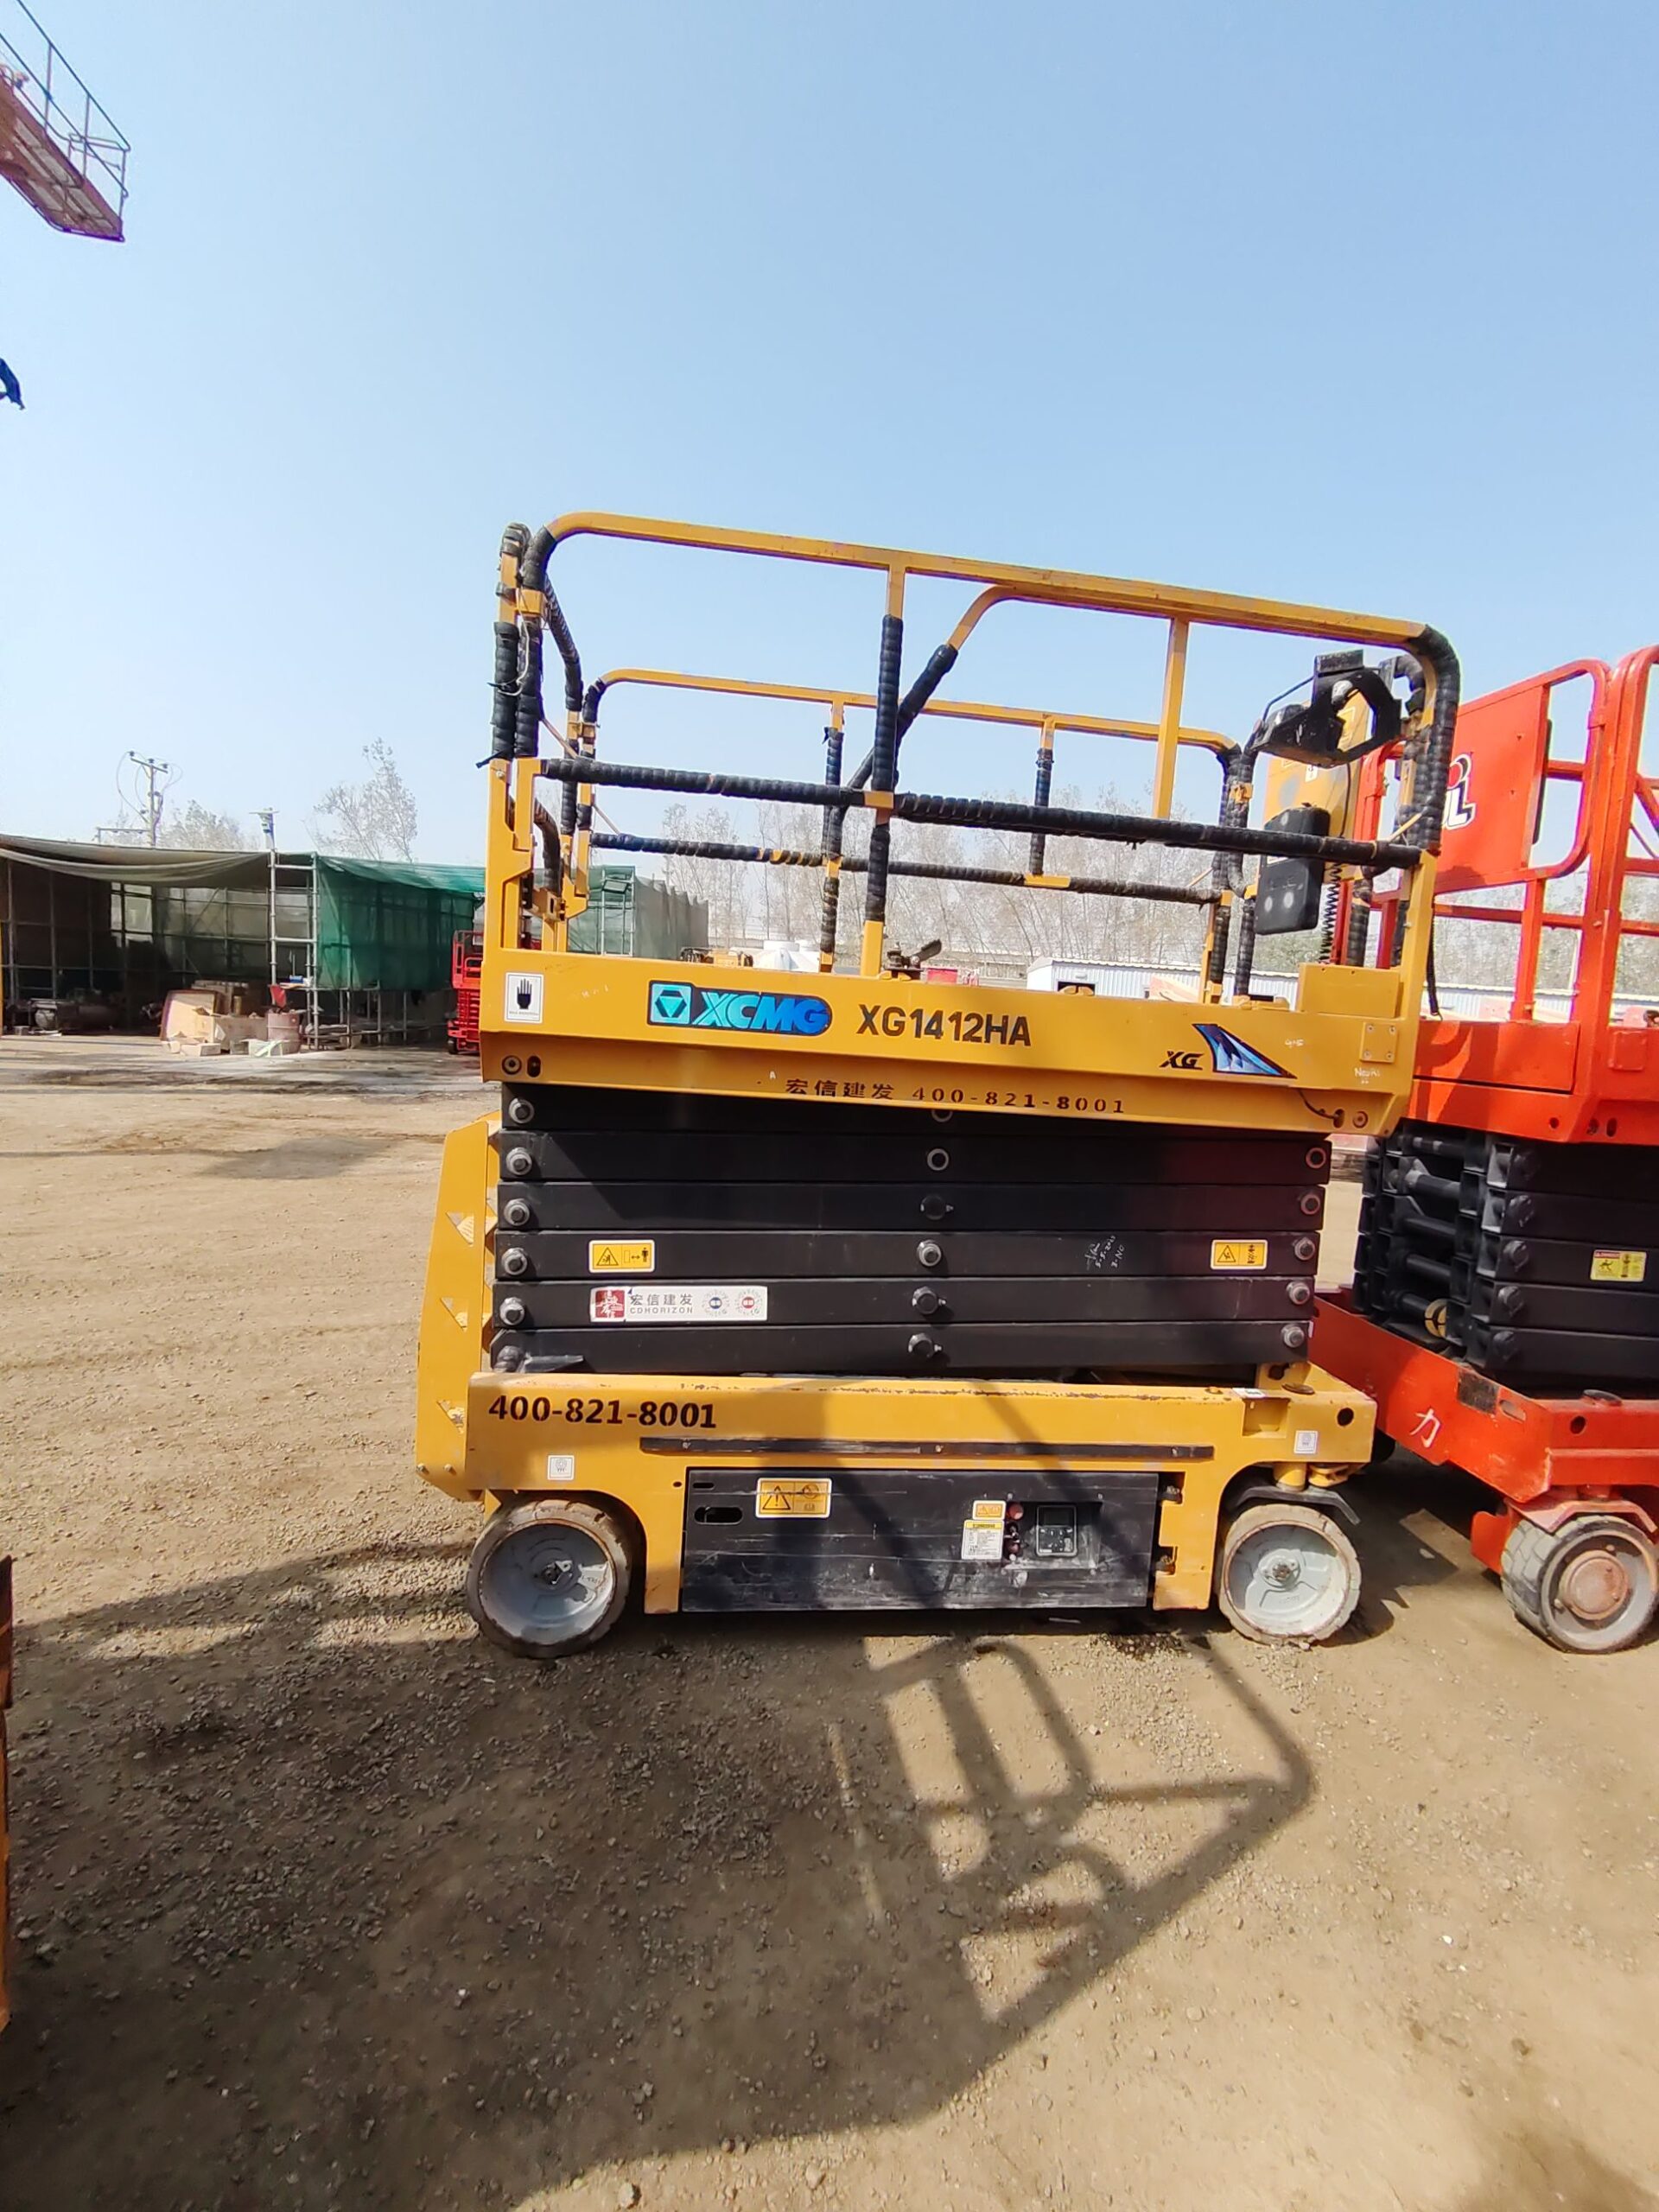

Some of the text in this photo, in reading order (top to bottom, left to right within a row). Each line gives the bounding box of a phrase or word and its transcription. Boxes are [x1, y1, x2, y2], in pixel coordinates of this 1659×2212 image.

[692, 991, 829, 1034] XCMG
[856, 1004, 1031, 1046] XG1412HA
[1159, 1051, 1205, 1071] XG
[785, 1078, 1124, 1114] 宏信建发 400-821-8001
[630, 1294, 693, 1306] 宏信建发
[488, 1395, 716, 1428] 400-821-8001
[1410, 1408, 1440, 1448] 力
